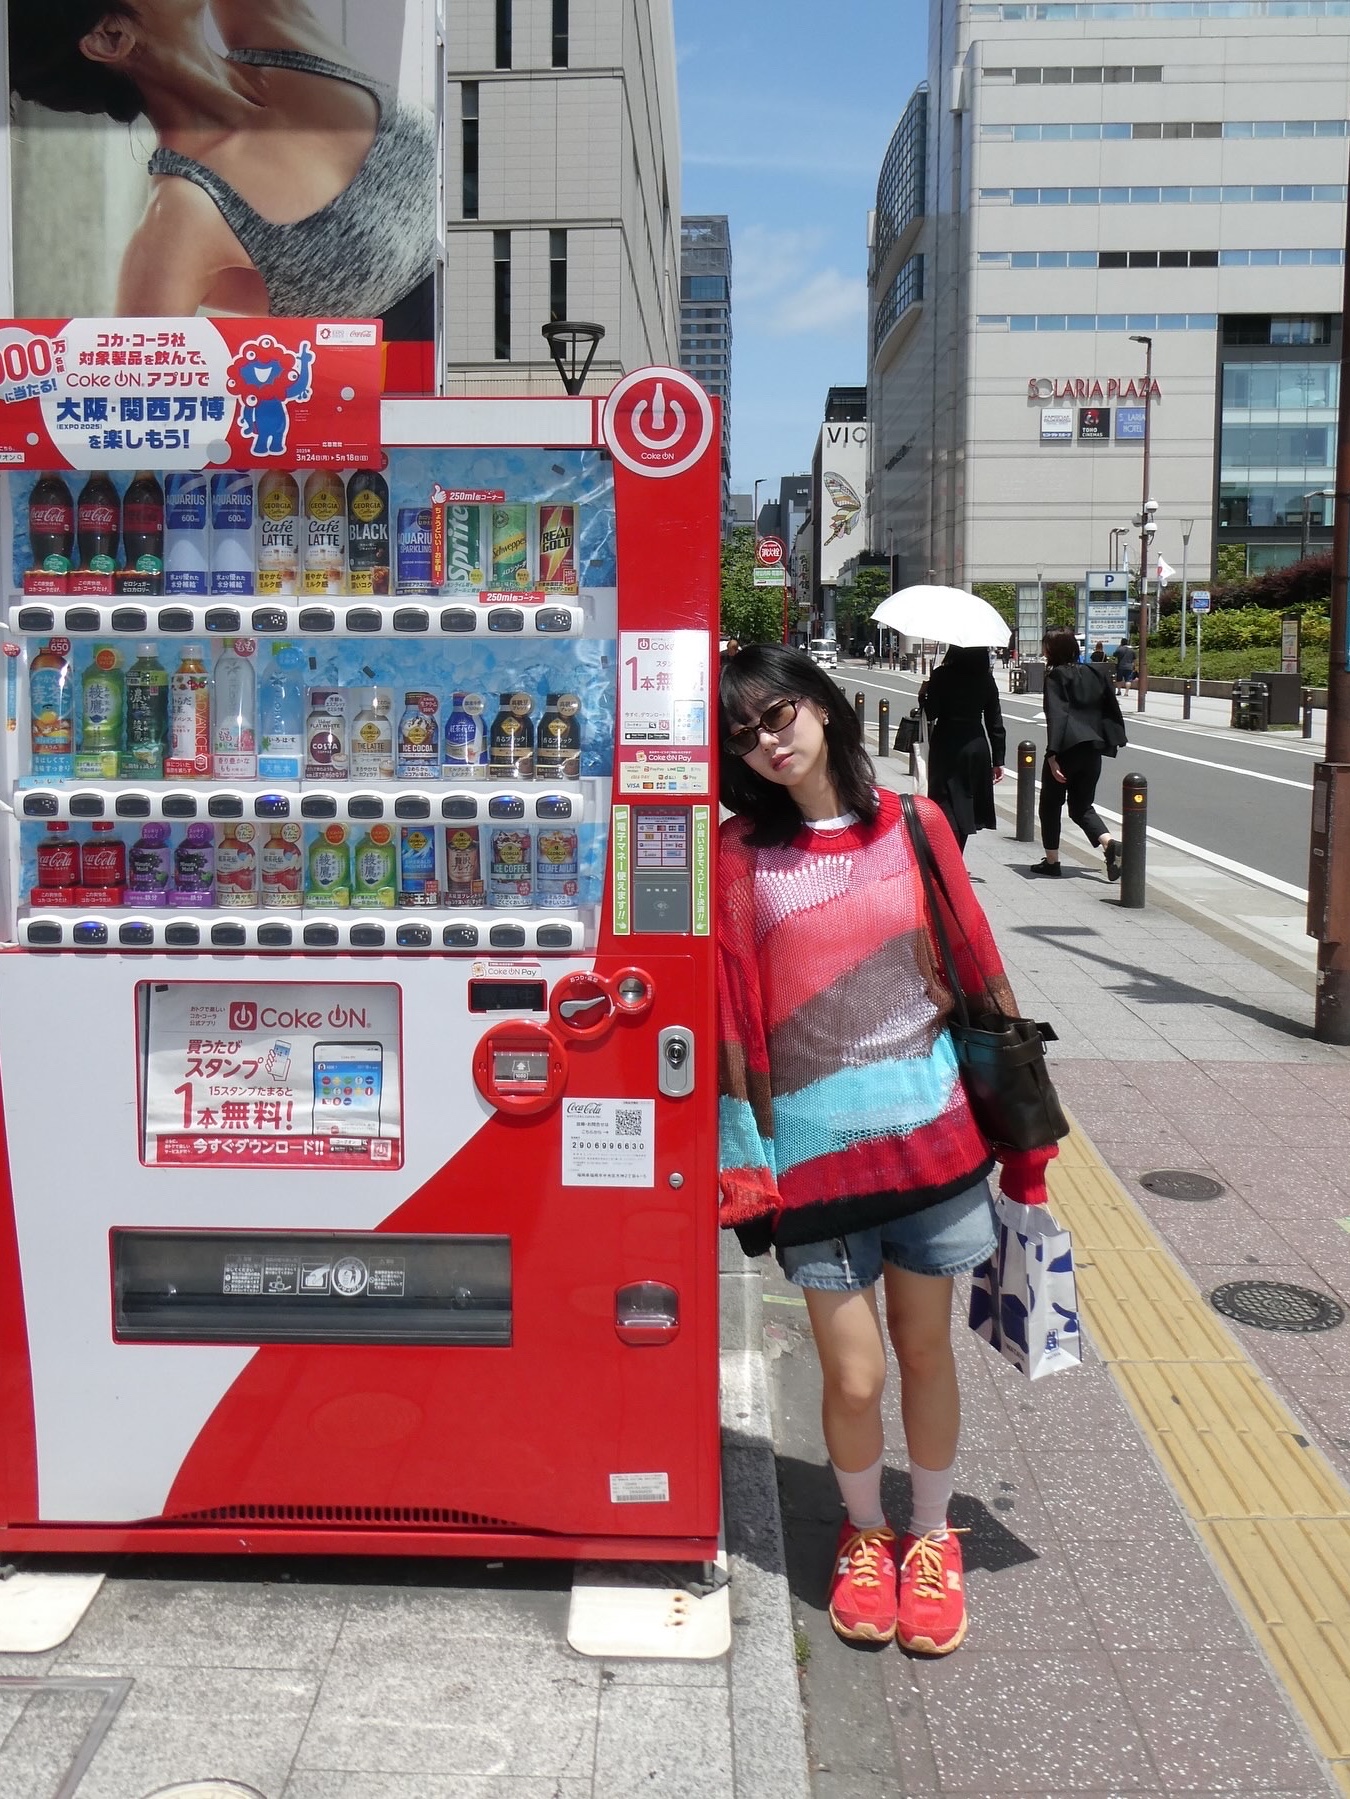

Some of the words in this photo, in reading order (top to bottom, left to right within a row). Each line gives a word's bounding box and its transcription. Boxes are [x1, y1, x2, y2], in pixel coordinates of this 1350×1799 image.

[97, 333, 186, 347] コカ・コーラ社
[0, 339, 51, 385] 00
[79, 351, 207, 366] 対象製品を飲んで、
[66, 373, 110, 387] Coke
[147, 372, 209, 387] アプリで
[5, 378, 57, 402] に当たる!
[1028, 378, 1103, 398] SOLARIA
[1109, 378, 1162, 398] PLAZA
[56, 396, 225, 422] 大阪・関西万博
[89, 429, 189, 449] を楽しもう!
[641, 452, 661, 460] Coke
[262, 520, 293, 533] Café
[308, 520, 339, 533] Café
[350, 523, 388, 540] BLACK
[262, 534, 293, 547] LATTE
[308, 534, 339, 547] LATTE
[398, 532, 432, 545] QUARIU
[542, 526, 571, 542] REAL
[448, 506, 474, 581] Sprite
[543, 538, 571, 552] GOLD
[762, 548, 780, 557] 消火栓
[1105, 575, 1114, 587] P
[51, 643, 68, 651] 650
[494, 864, 503, 872] ICE
[504, 864, 528, 872] COFFEE
[414, 893, 437, 904] 王道
[488, 967, 507, 976] Coke
[522, 969, 537, 977] Pay
[260, 1008, 322, 1029] Coke
[187, 1039, 242, 1055] 買うたび
[185, 1057, 263, 1079] スタンプ
[209, 1085, 293, 1097] 15スタンプたまると
[174, 1082, 293, 1130] 1本無料!
[567, 1102, 602, 1114] Coca-Cola
[193, 1138, 324, 1156] 今すぐダウンロード!!
[946, 1570, 961, 1591] N
